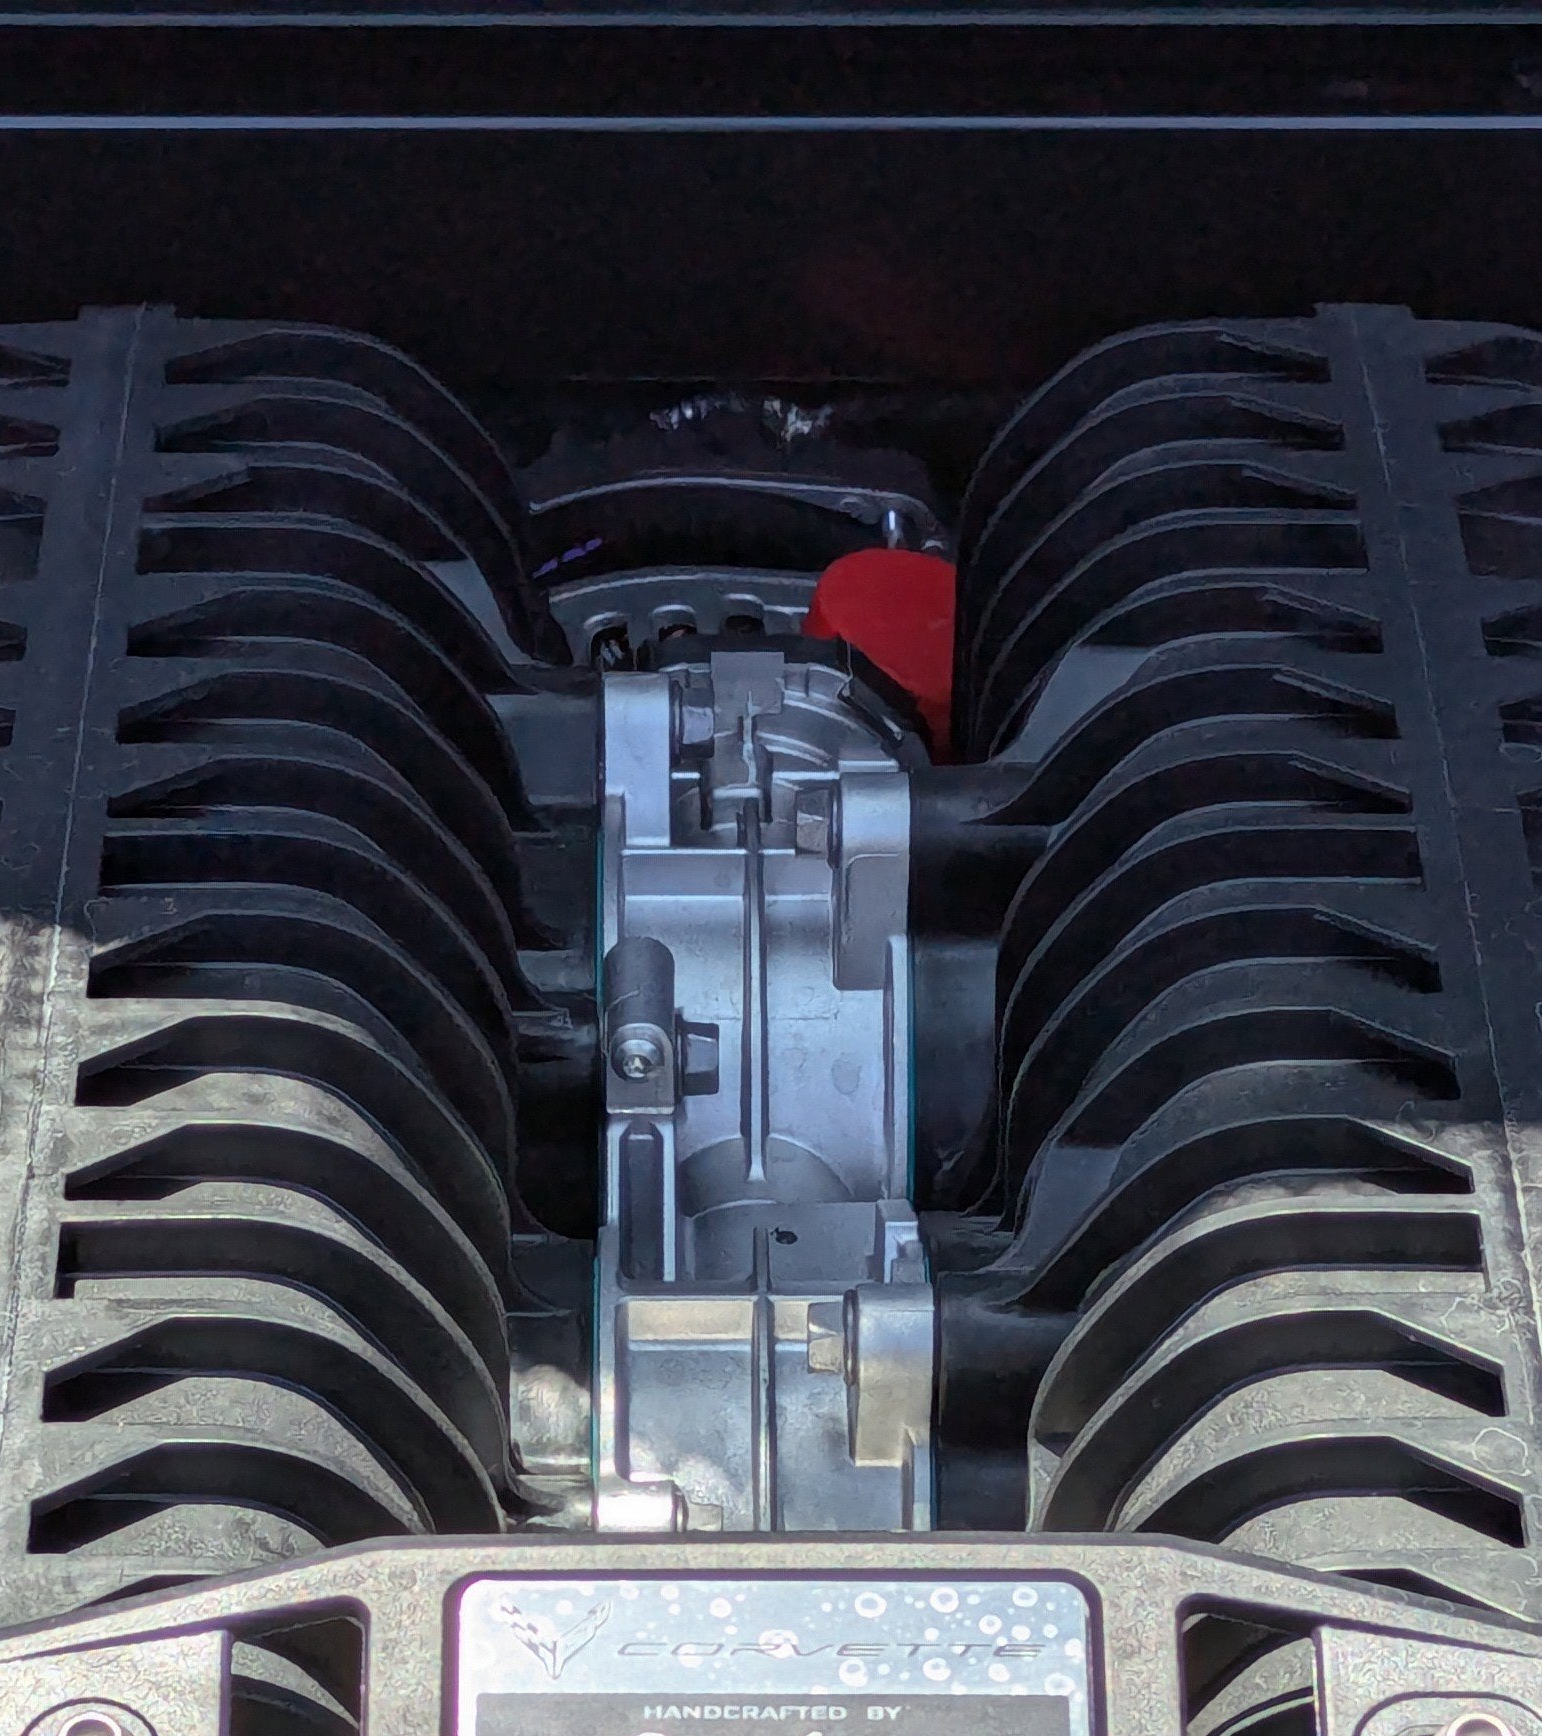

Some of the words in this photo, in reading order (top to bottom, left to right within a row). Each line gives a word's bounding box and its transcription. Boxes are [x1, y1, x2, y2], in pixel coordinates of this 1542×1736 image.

[616, 1642, 1046, 1659] CORVETTE
[643, 1705, 848, 1721] HANDCRAFTED
[867, 1705, 902, 1721] BY
